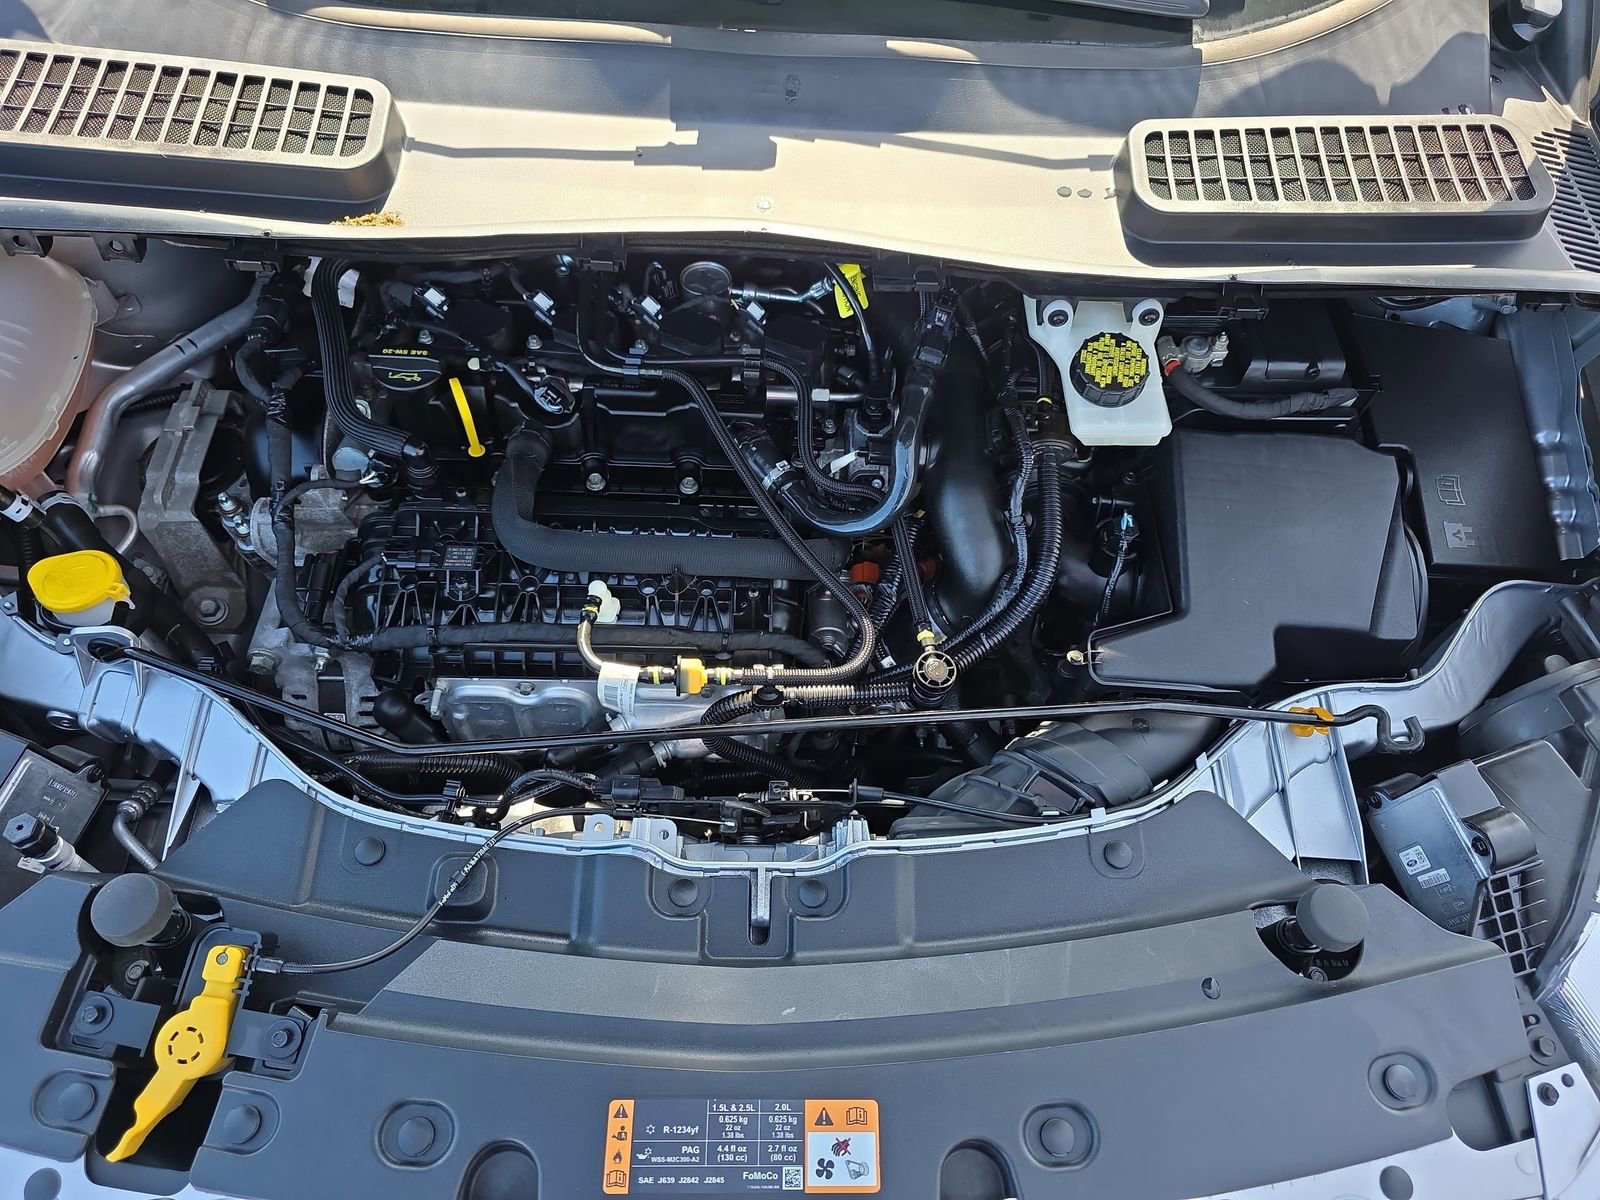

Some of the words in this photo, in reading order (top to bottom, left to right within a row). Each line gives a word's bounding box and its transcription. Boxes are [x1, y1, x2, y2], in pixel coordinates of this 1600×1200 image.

[712, 1103, 729, 1112] 1.5L
[730, 1103, 737, 1112] &
[738, 1103, 756, 1112] 2.5L
[774, 1103, 792, 1111] 2.0L
[718, 1115, 738, 1123] 0.625
[738, 1115, 748, 1125] kg
[768, 1115, 788, 1123] 0.625
[788, 1115, 798, 1125] kg
[663, 1125, 700, 1135] R-1234yf
[681, 1145, 700, 1154] PAG
[717, 1153, 734, 1163] (130
[735, 1153, 748, 1163] cc)
[770, 1153, 783, 1162] (80
[783, 1153, 796, 1162] cc)
[638, 1176, 654, 1184] SAE
[657, 1176, 676, 1184] J639
[678, 1176, 700, 1184] J2842
[703, 1176, 725, 1184] J2845
[742, 1171, 779, 1180] FoMoCo
